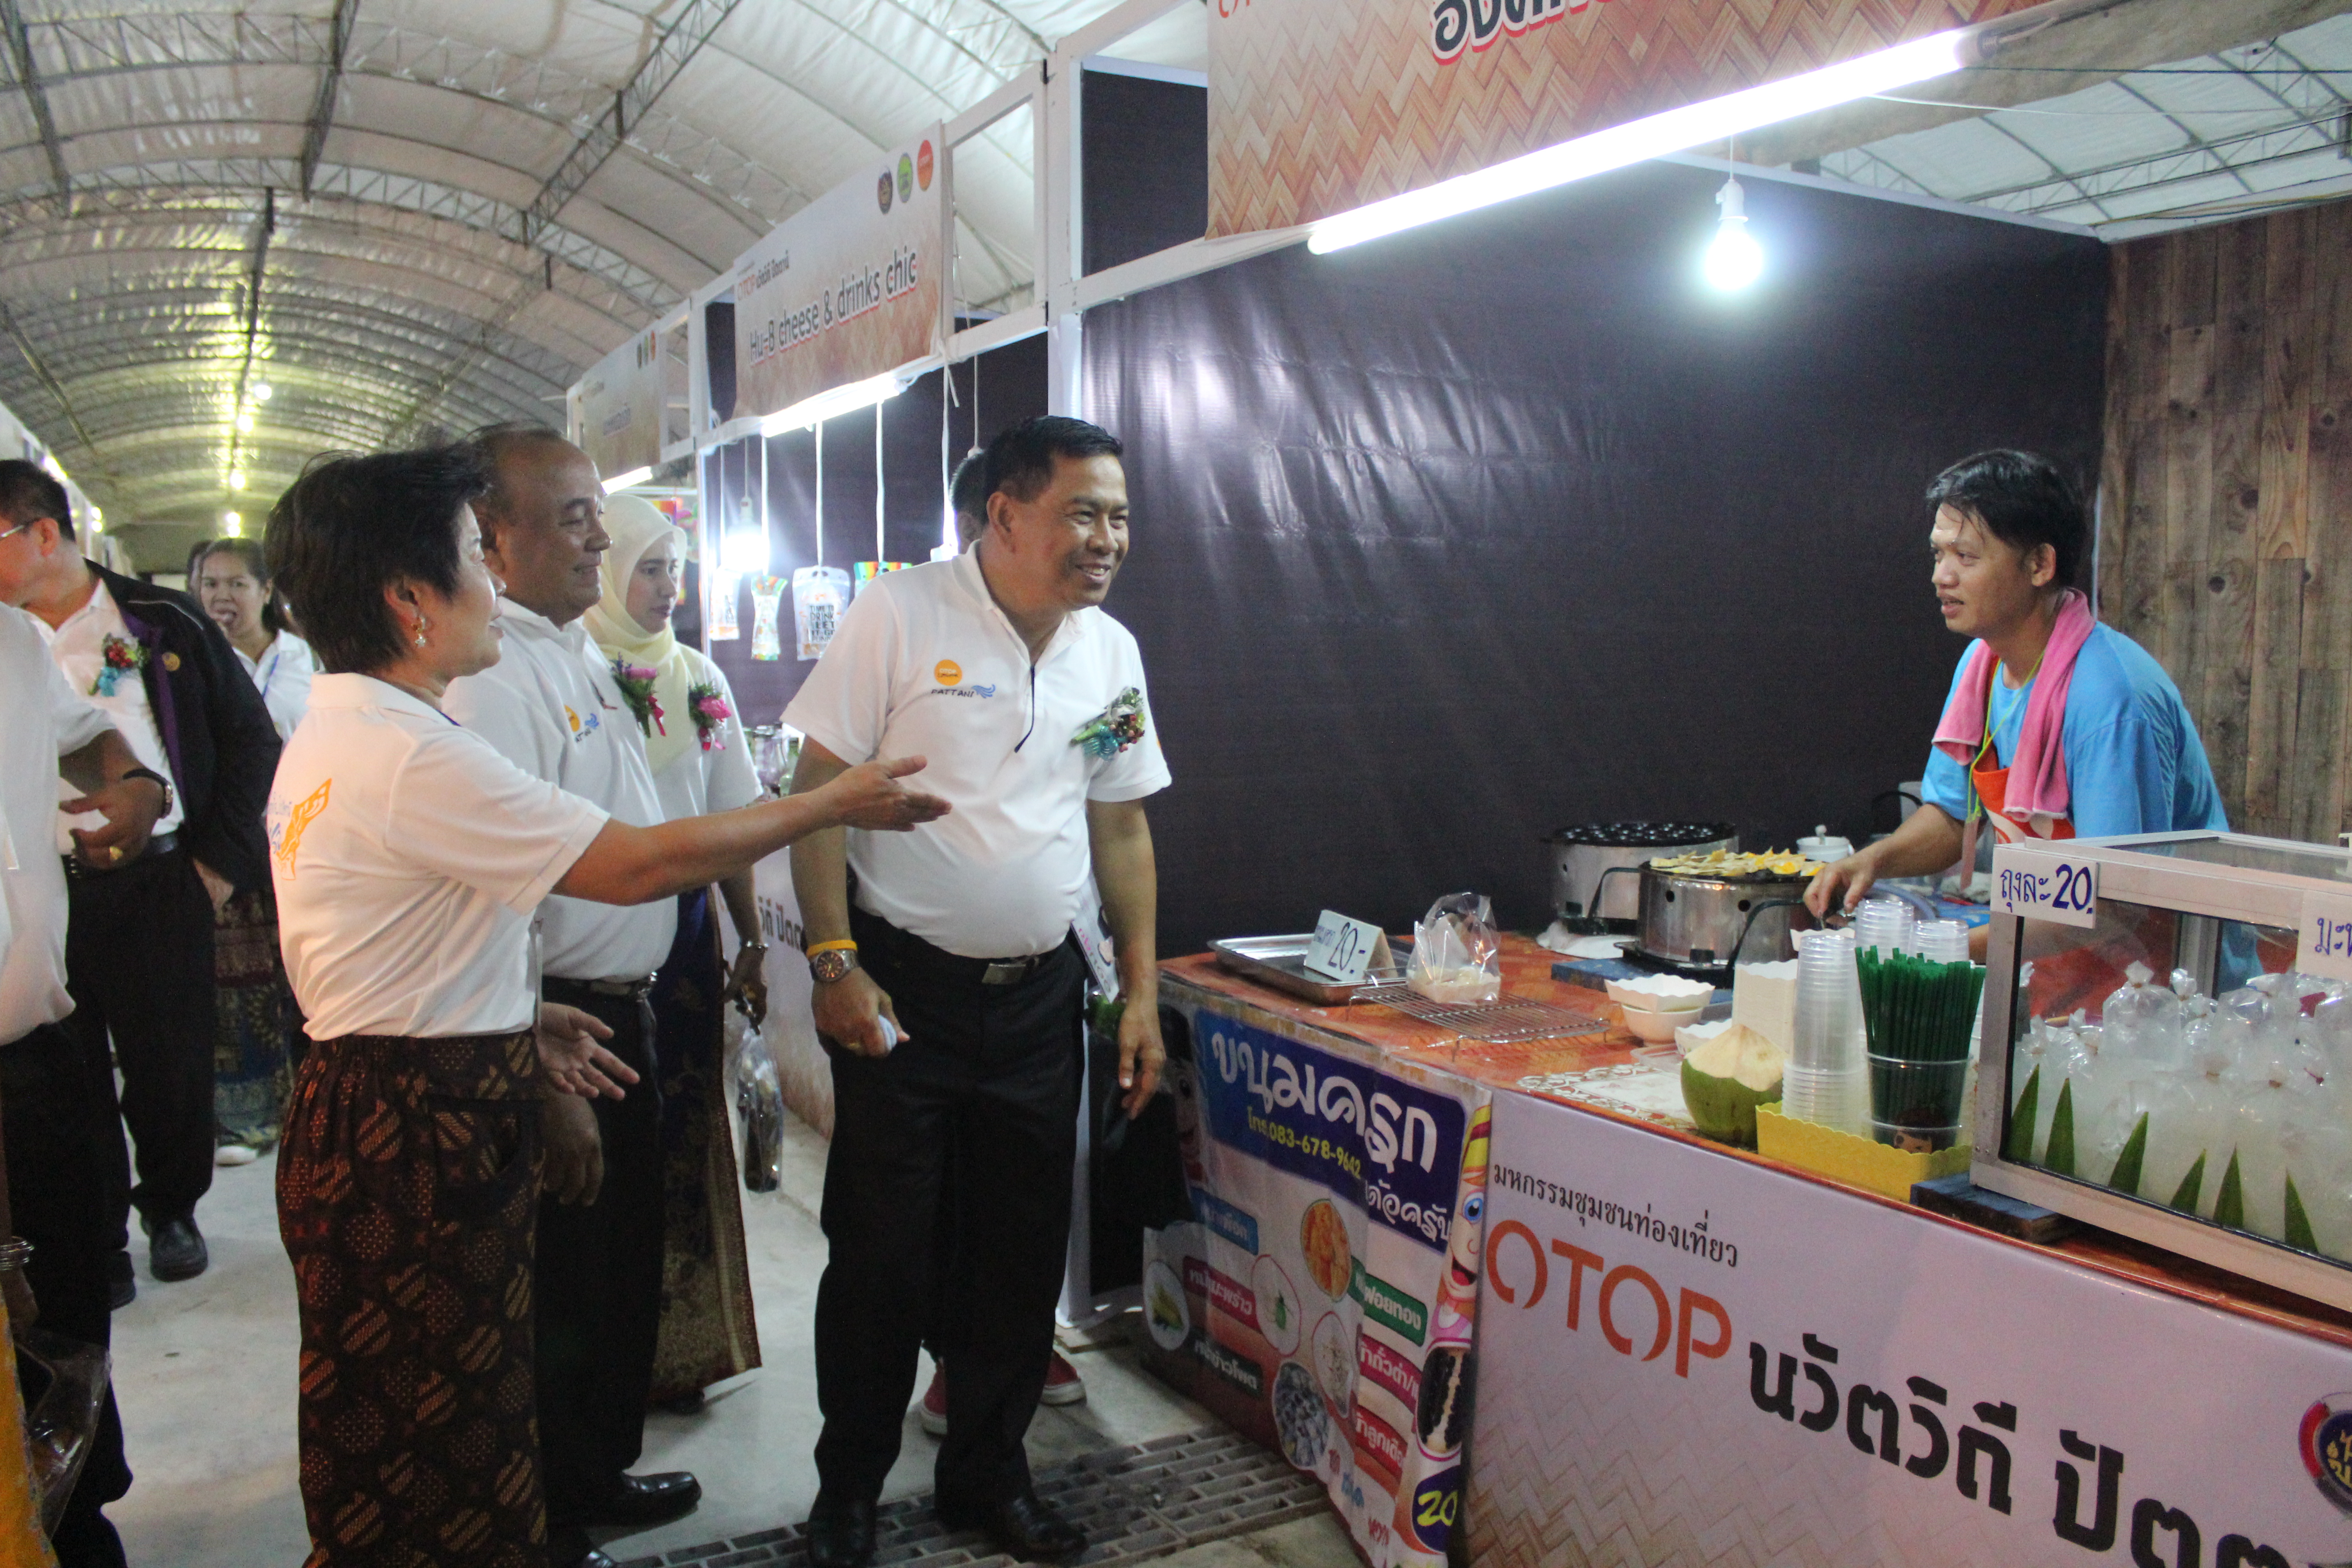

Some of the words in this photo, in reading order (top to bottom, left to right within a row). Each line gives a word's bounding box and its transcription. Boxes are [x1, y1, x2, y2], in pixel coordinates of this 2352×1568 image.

[750, 319, 774, 362] Hu-B
[779, 304, 818, 347] cheese
[824, 289, 833, 325] &
[837, 265, 880, 318] drinks
[886, 245, 916, 294] chic
[810, 612, 834, 621] DRINK
[931, 689, 975, 697] PATTANI
[1211, 1032, 1437, 1174] ขนมครก
[1494, 1163, 1738, 1269] มหกรรมชุมชนท่องเที่ยว
[1485, 1218, 1732, 1378] OTOP
[1749, 1333, 2019, 1516] นวัตวิถี
[1416, 1490, 1458, 1527] 20
